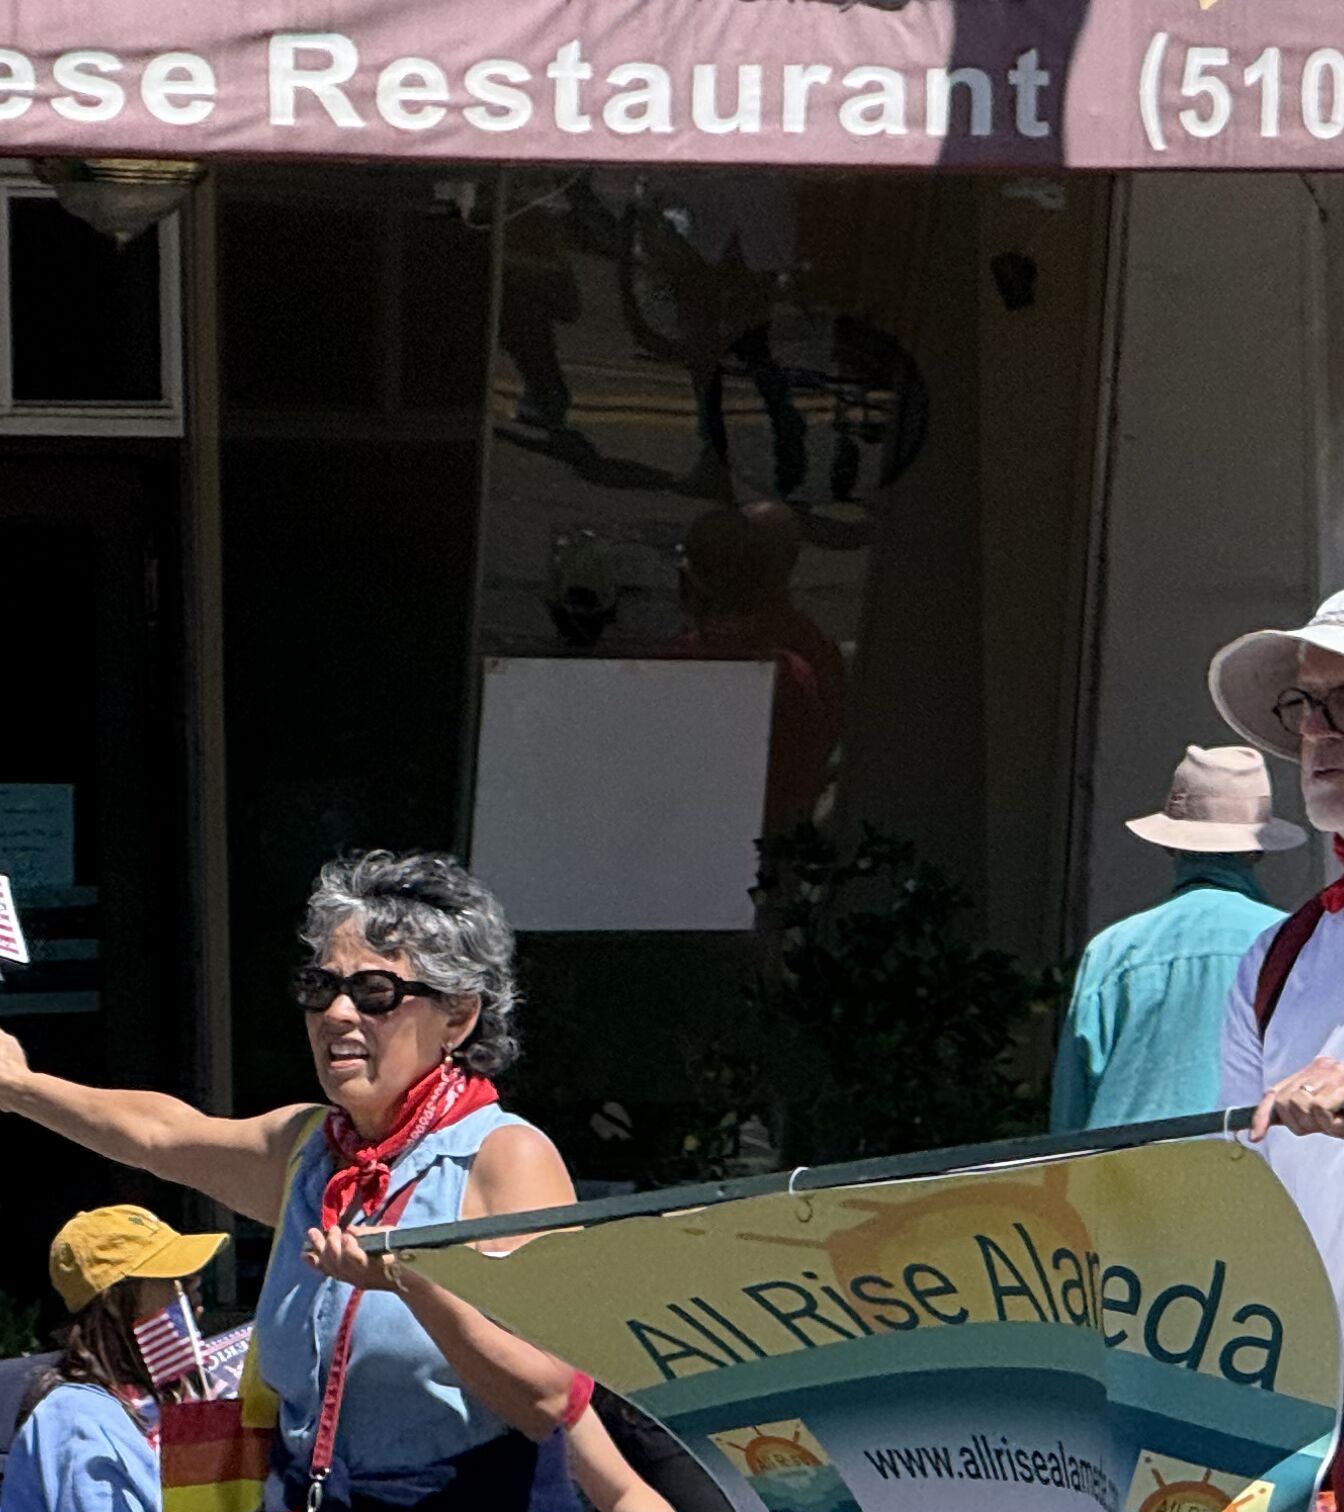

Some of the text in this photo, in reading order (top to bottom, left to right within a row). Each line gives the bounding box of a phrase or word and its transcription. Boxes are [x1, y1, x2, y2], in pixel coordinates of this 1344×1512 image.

[265, 31, 1052, 139] Restaurant
[625, 1295, 764, 1382] All
[743, 1261, 969, 1350] Rise
